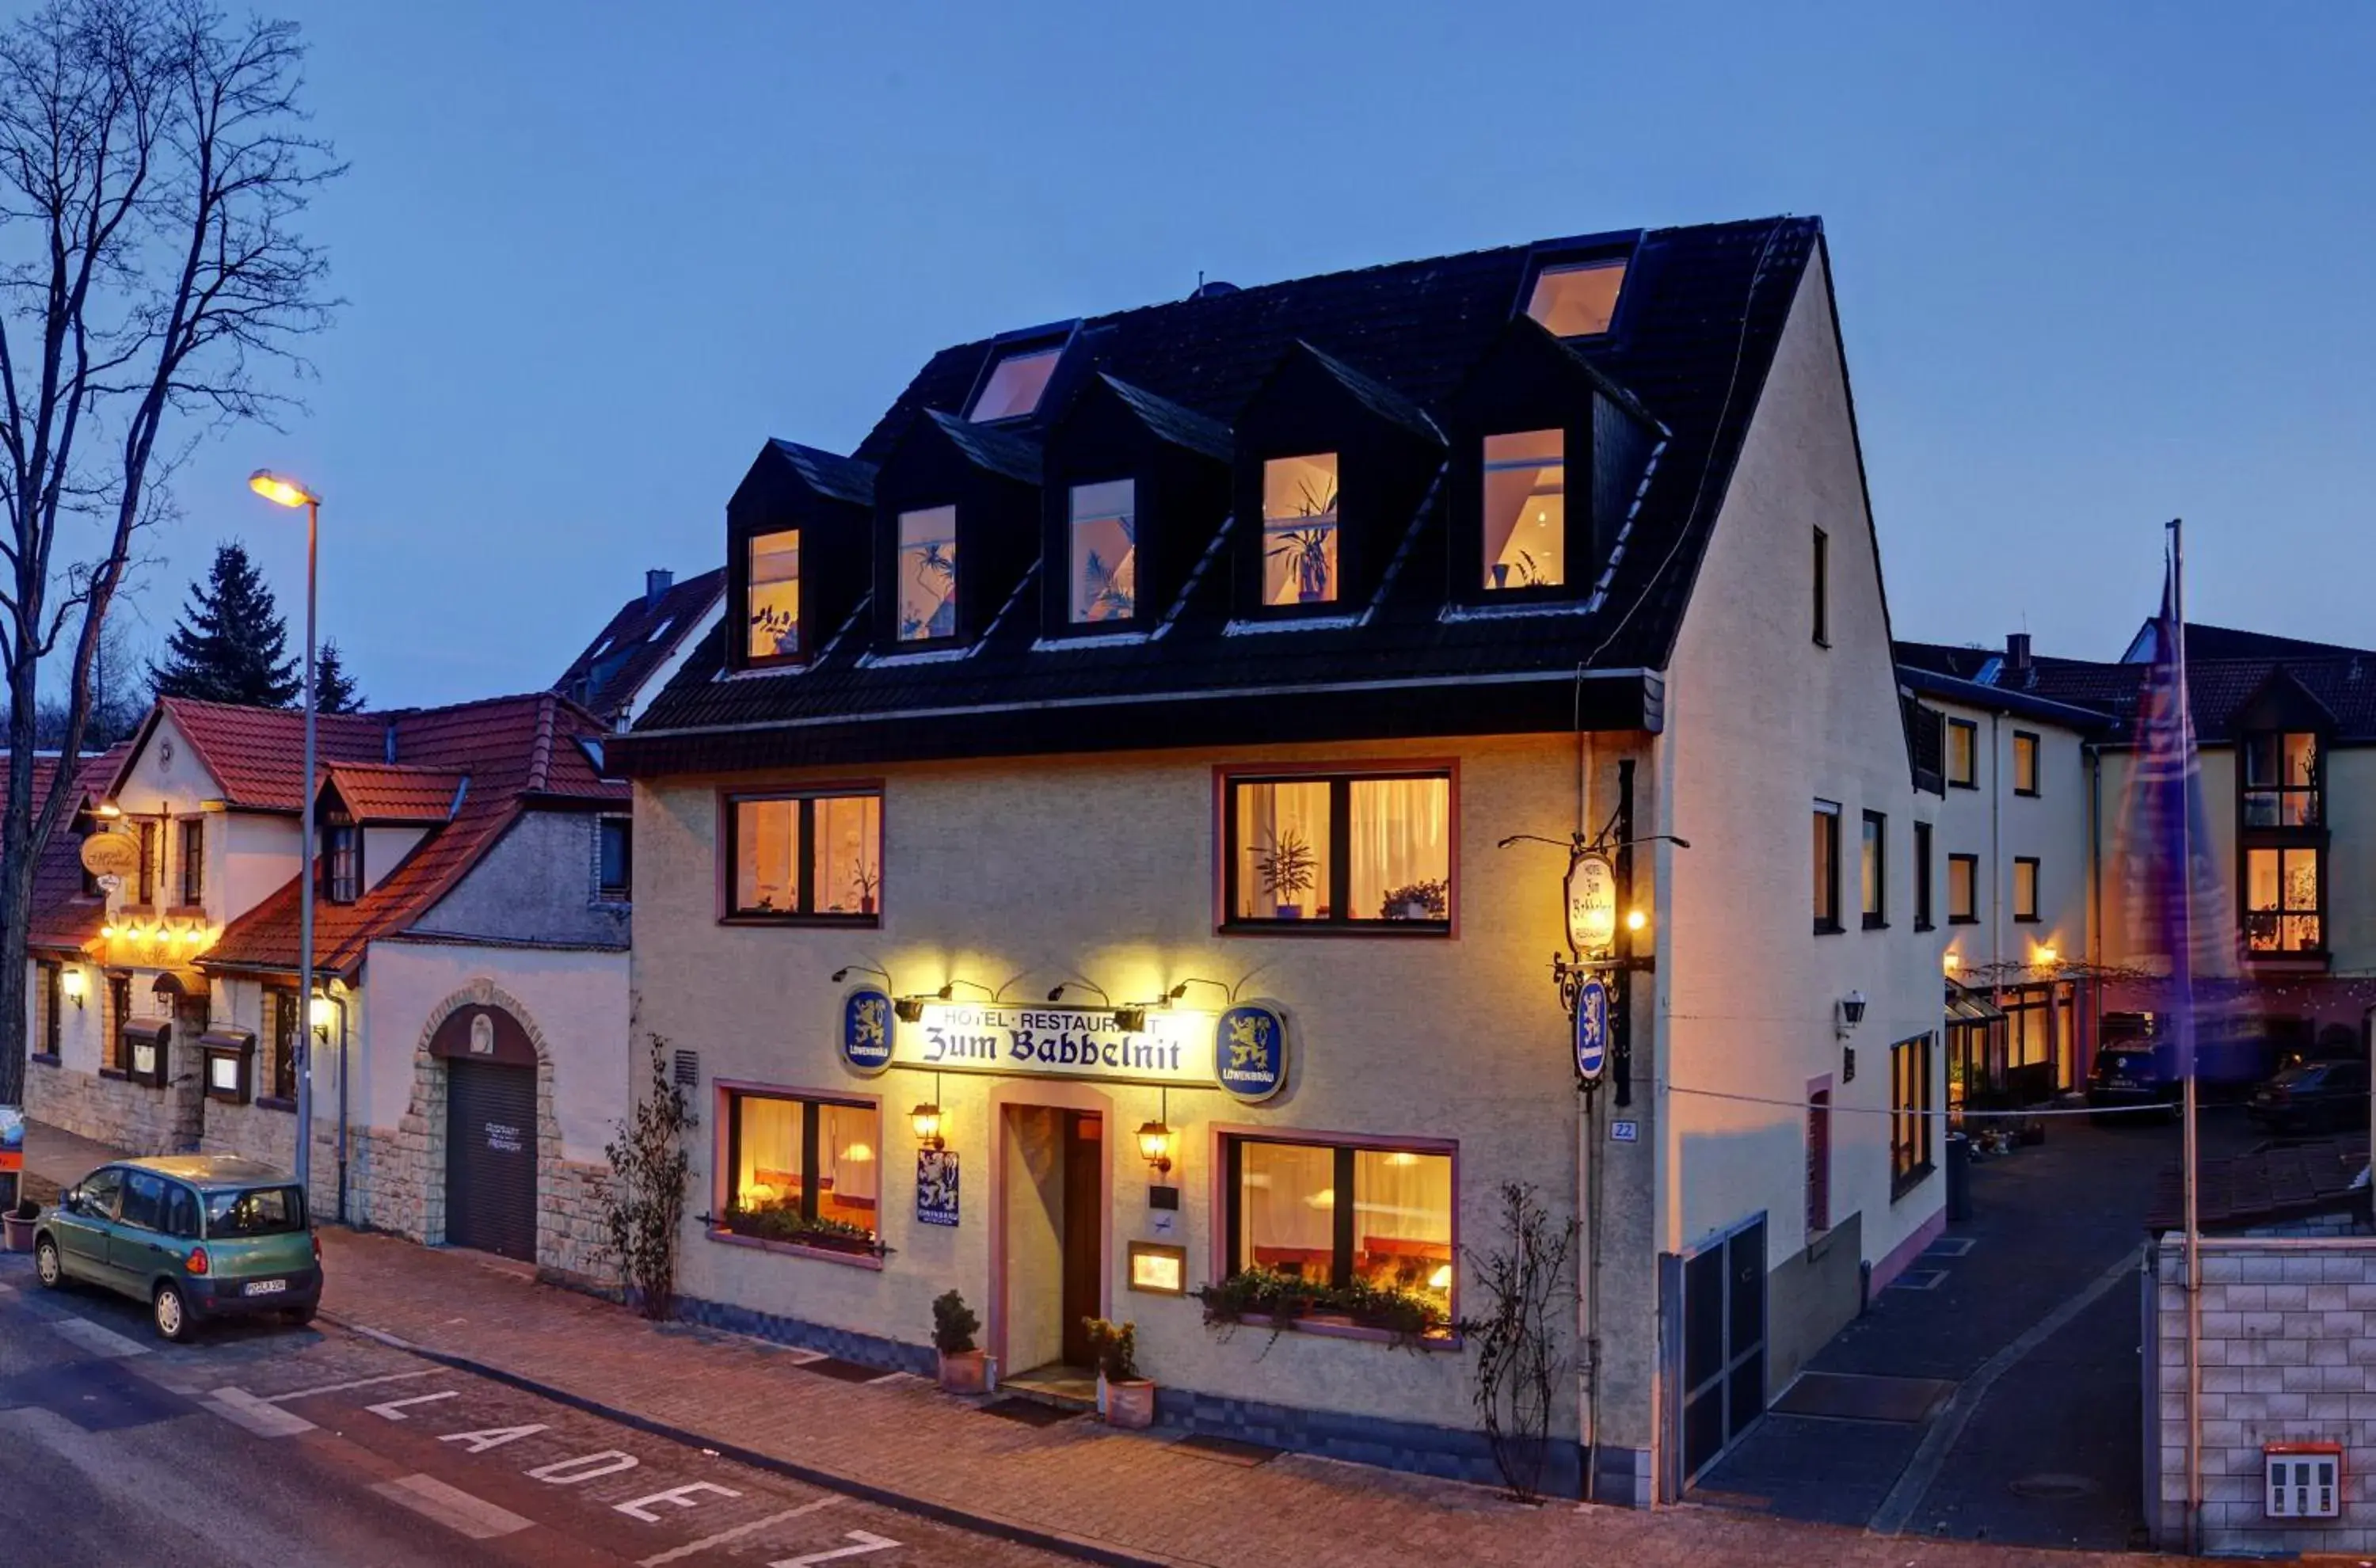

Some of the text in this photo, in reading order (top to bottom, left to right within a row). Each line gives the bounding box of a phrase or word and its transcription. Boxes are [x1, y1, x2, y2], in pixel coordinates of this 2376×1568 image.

[944, 1009, 1161, 1034] HOTEL RESTAURT
[923, 1026, 1181, 1071] Zum Babbelnit
[1615, 1124, 1632, 1137] 22
